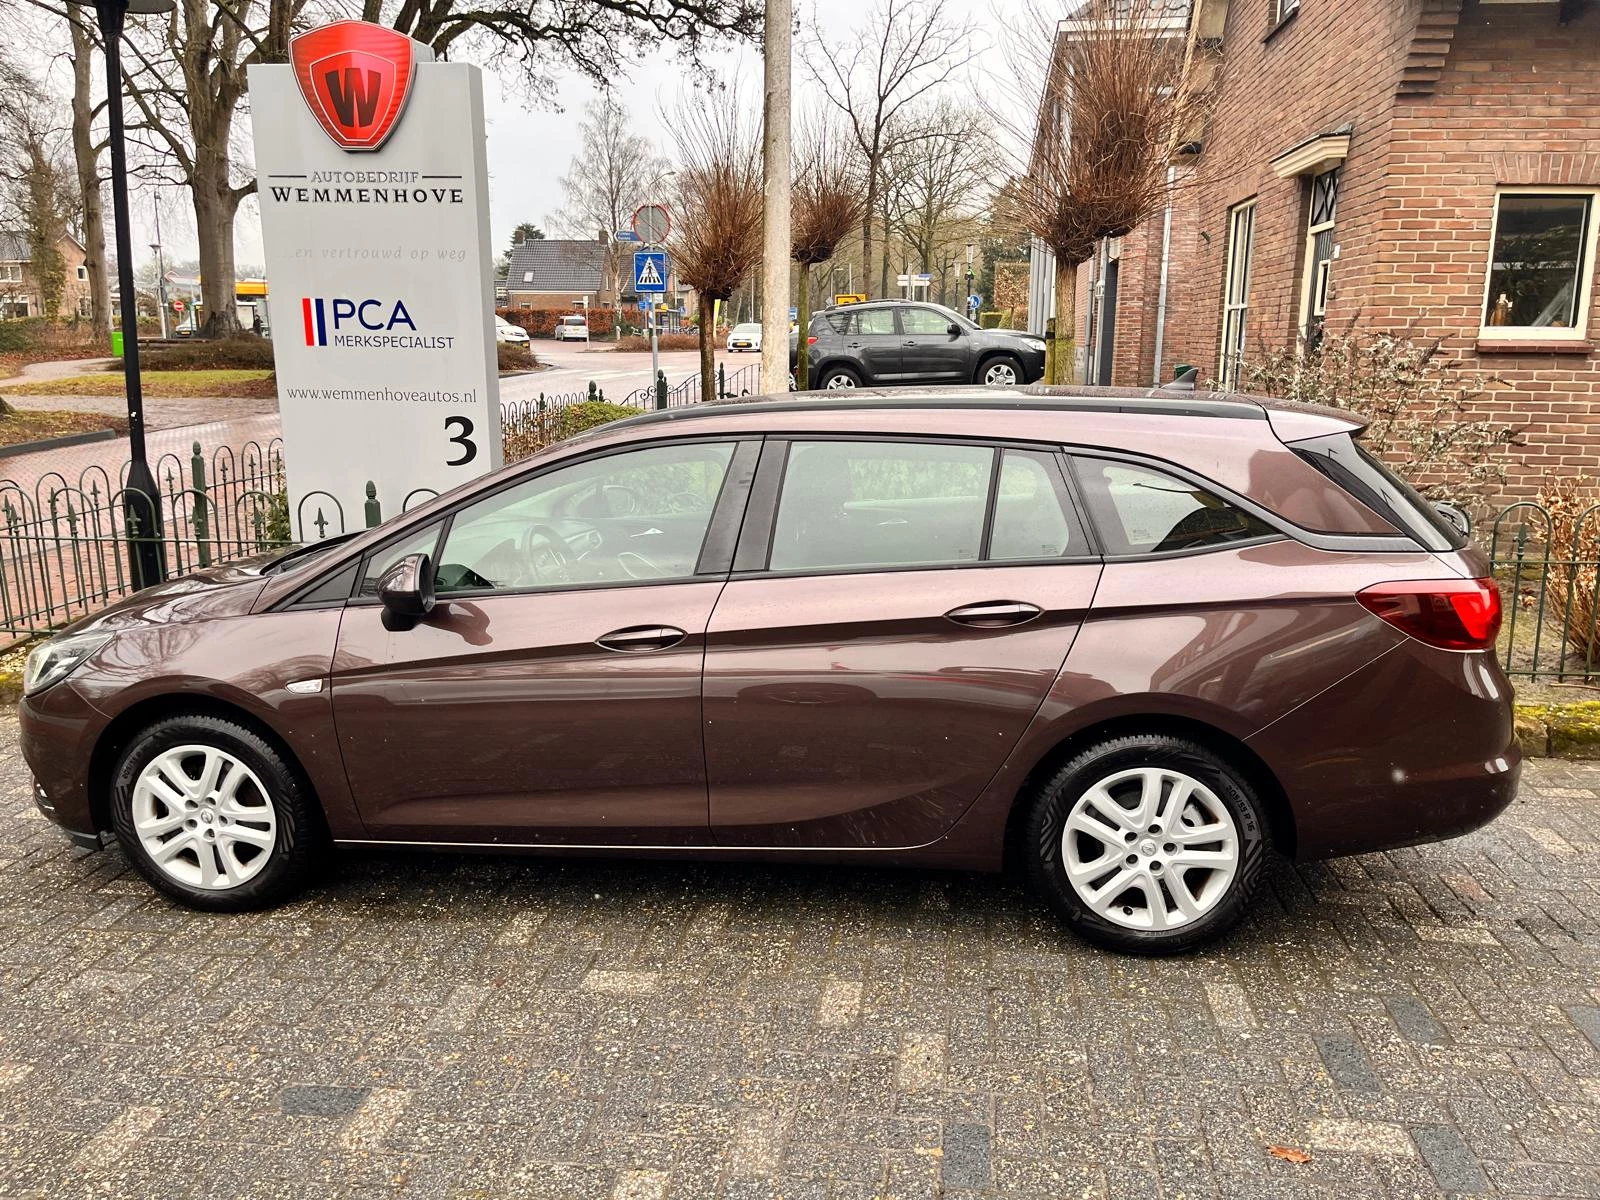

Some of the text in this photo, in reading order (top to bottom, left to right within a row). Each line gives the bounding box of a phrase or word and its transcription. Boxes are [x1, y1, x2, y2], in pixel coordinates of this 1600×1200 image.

[325, 68, 382, 128] W
[310, 171, 420, 184] AUTOBEDRIJF
[271, 186, 464, 204] WEMMENHOVE
[321, 246, 402, 259] vertrouwd
[410, 249, 429, 262] op
[437, 248, 467, 263] weg
[332, 299, 417, 331] PCA
[334, 335, 455, 349] MERKSPECIALIST
[286, 386, 478, 404] www.wemmenhoveautos.nl
[443, 415, 478, 467] 3
